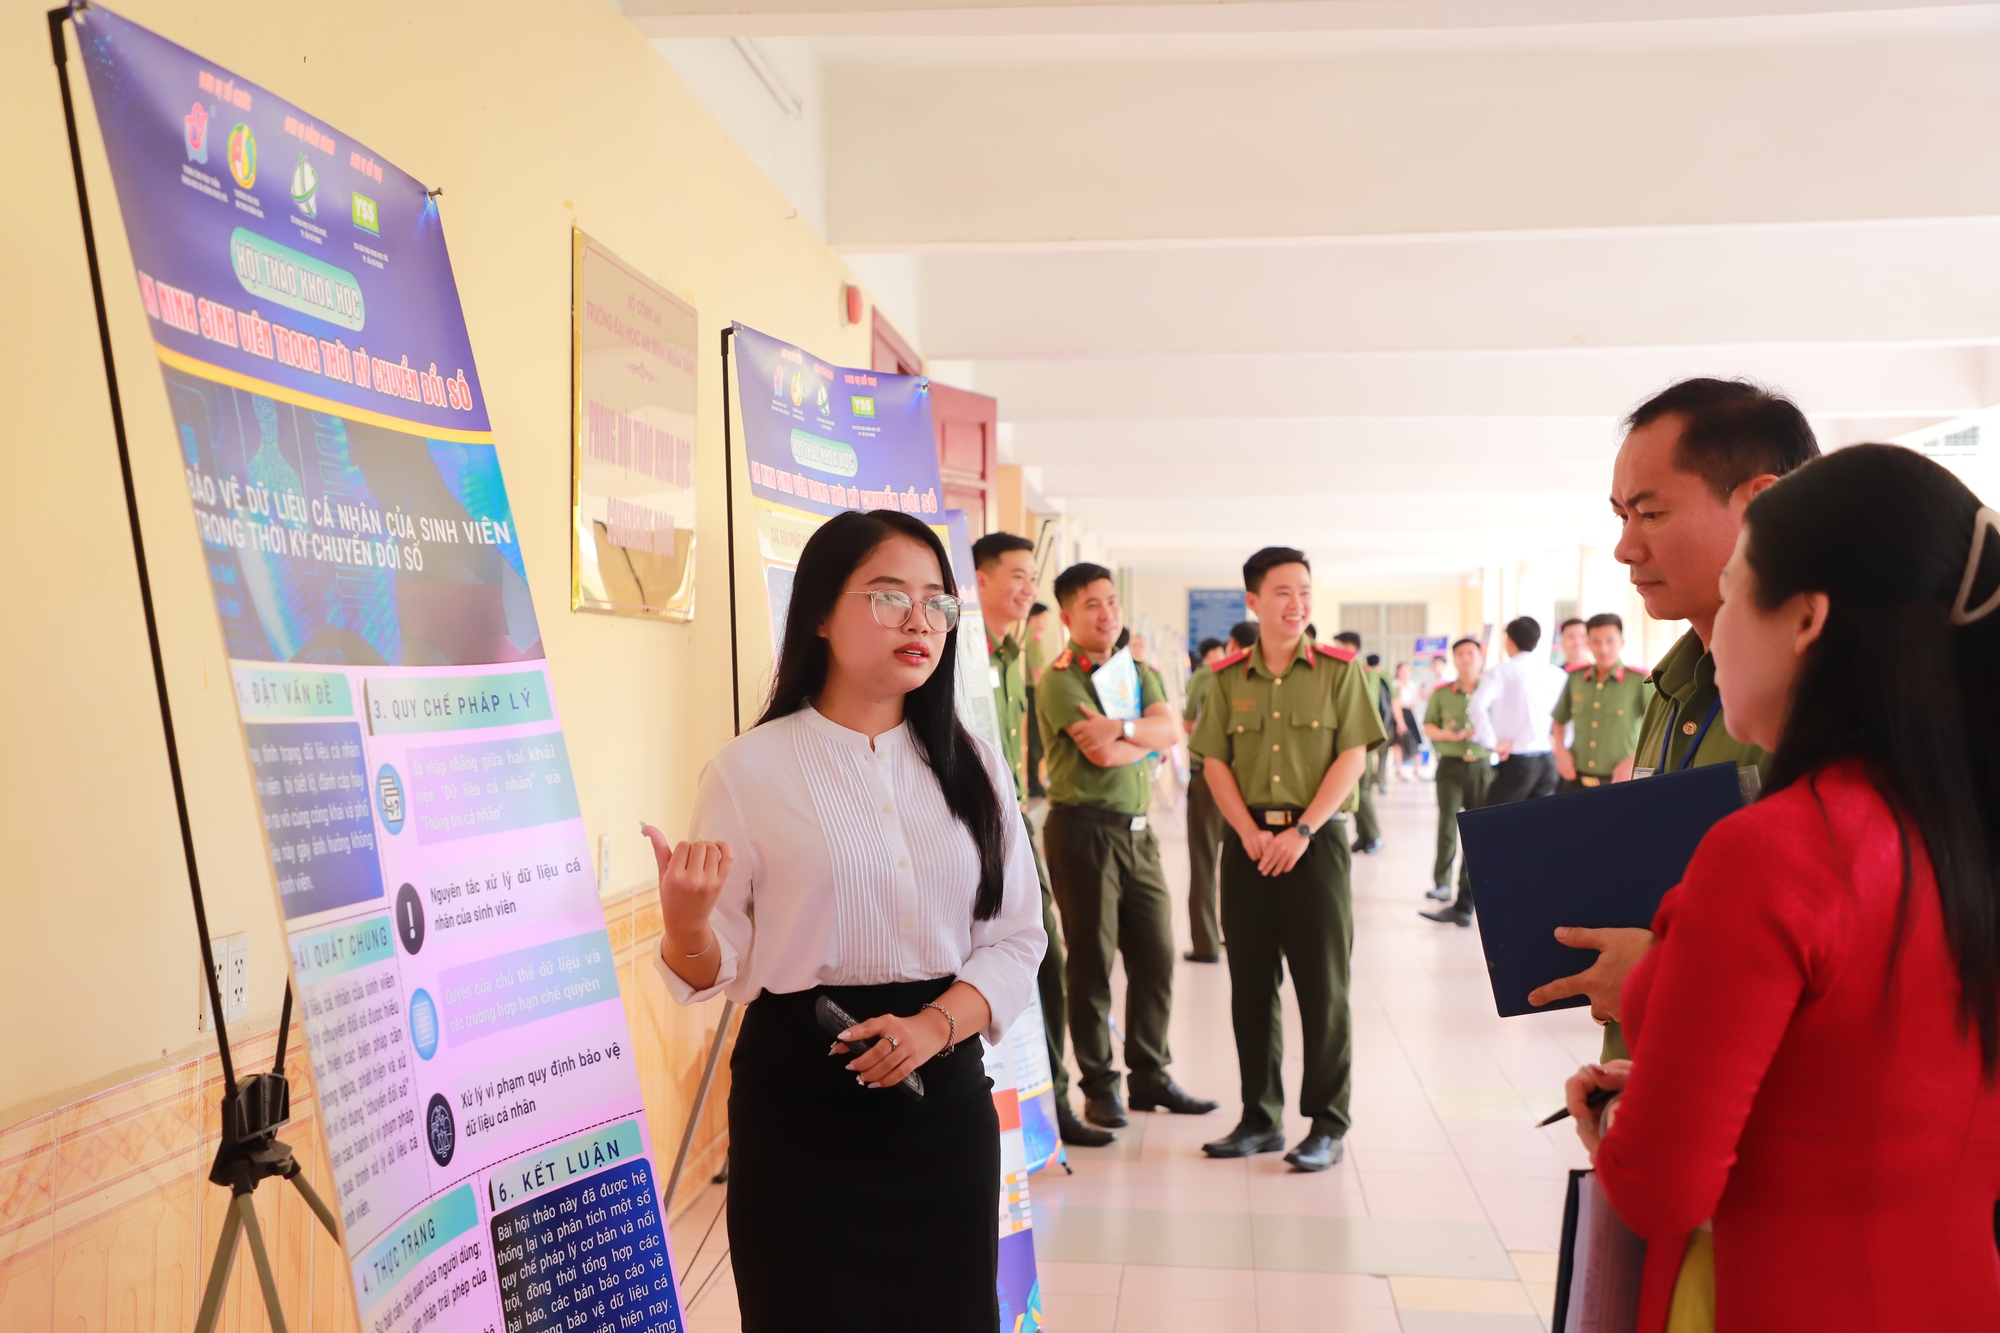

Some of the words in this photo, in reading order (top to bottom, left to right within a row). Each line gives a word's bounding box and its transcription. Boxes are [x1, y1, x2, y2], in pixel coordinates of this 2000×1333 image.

[354, 196, 374, 222] YSS
[236, 241, 260, 288] HỘI
[262, 252, 297, 297] THẢO
[299, 268, 333, 310] KHOA
[335, 281, 360, 323] HỌC
[156, 280, 198, 335] NINH
[198, 297, 237, 348] SINH
[237, 309, 273, 360] VIÊN
[273, 324, 320, 374] TRONG
[320, 338, 352, 383] THỜI
[353, 348, 370, 388] KỲ
[372, 354, 420, 402] CHUYỂN
[420, 362, 447, 408] ĐỔI
[447, 369, 472, 411] SỐ
[854, 398, 871, 412] YSS
[218, 475, 242, 517] VỆ
[245, 481, 269, 516] DỮ
[274, 488, 308, 524] LIỆU
[312, 495, 334, 528] CÁ
[337, 502, 381, 535] NHÂN
[386, 505, 416, 539] CỦA
[420, 517, 458, 543] SINH
[462, 516, 511, 544] VIÊN
[900, 486, 920, 513] ĐỔI
[921, 488, 937, 513] SỐ
[247, 518, 287, 555] THỜI
[289, 523, 307, 558] KỲ
[312, 532, 372, 566] CHUYỂN
[376, 536, 401, 569] ĐỔI
[404, 540, 423, 571] SỐ
[252, 678, 276, 709] ĐẶT
[283, 678, 310, 704] VẤN
[316, 678, 331, 704] ĐỀ
[374, 700, 386, 719] 3.
[392, 699, 417, 720] QUY
[424, 692, 451, 716] CHẾ
[458, 691, 500, 715] PHÁP
[509, 687, 531, 710] LÝ
[481, 750, 503, 771] giữa
[507, 750, 523, 765] hai
[528, 744, 555, 761] khái
[462, 781, 480, 800] liệu
[486, 780, 498, 794] cá
[546, 769, 561, 785] và
[430, 882, 461, 906] Nguyên
[465, 878, 480, 896] tắc
[485, 873, 497, 892] xử
[502, 872, 512, 892] lý
[517, 867, 531, 884] dữ
[536, 862, 559, 884] liệu
[565, 857, 581, 874] cá
[434, 914, 455, 931] nhân
[456, 908, 472, 926] của
[474, 904, 493, 921] sinh
[495, 900, 516, 917] viên
[350, 926, 387, 955] CHUNG
[474, 976, 492, 995] của
[495, 969, 514, 989] chủ
[539, 961, 554, 978] dữ
[558, 954, 580, 973] liệu
[584, 949, 600, 965] và
[498, 1001, 516, 1019] hợp
[518, 992, 538, 1013] hạn
[541, 984, 561, 1006] chế
[564, 978, 600, 1001] quyền
[460, 1088, 473, 1109] Xử
[475, 1086, 483, 1107] lý
[486, 1082, 494, 1099] vi
[496, 1074, 525, 1099] phạm
[527, 1067, 547, 1087] quy
[550, 1054, 576, 1078] định
[578, 1048, 601, 1067] bảo
[604, 1042, 621, 1059] vệ
[465, 1118, 477, 1137] dữ
[478, 1112, 495, 1133] liệu
[496, 1106, 509, 1123] cá
[510, 1098, 536, 1120] nhân
[499, 1182, 514, 1202] 6.
[522, 1160, 555, 1192] KẾT
[567, 1138, 620, 1174] LUẬN
[498, 1223, 512, 1242] Bài
[514, 1217, 530, 1236] hội
[533, 1204, 556, 1224] thảo
[559, 1197, 578, 1219] này
[582, 1188, 596, 1206] đã
[600, 1178, 628, 1198] được
[631, 1168, 647, 1186] hệ
[498, 1243, 523, 1266] thống
[526, 1236, 538, 1254] lại
[541, 1229, 553, 1243] và
[556, 1221, 583, 1242] phân
[586, 1208, 606, 1227] tích
[610, 1198, 632, 1218] một
[636, 1188, 651, 1207] số
[374, 1246, 399, 1285] THỰC
[402, 1218, 435, 1259] TRẠNG
[425, 1266, 436, 1288] của
[438, 1256, 458, 1280] người
[501, 1272, 517, 1290] quy
[520, 1258, 537, 1279] chế
[540, 1249, 565, 1272] pháp
[568, 1242, 577, 1260] lý
[580, 1240, 594, 1252] cơ
[598, 1226, 617, 1246] bản
[620, 1219, 633, 1235] và
[637, 1210, 655, 1230] nổi
[504, 1294, 522, 1312] trội,
[526, 1278, 552, 1301] đồng
[556, 1266, 576, 1286] thời
[582, 1256, 606, 1275] tổng
[612, 1244, 633, 1264] hợp
[638, 1234, 659, 1250] các
[438, 1290, 450, 1312] trái
[452, 1278, 469, 1306] phép
[472, 1267, 487, 1288] của
[526, 1308, 547, 1325] báo,
[550, 1295, 570, 1313] các
[574, 1284, 594, 1305] bản
[599, 1274, 620, 1291] báo
[624, 1263, 645, 1279] cáo
[650, 1252, 664, 1269] về
[566, 1310, 587, 1330] bảo
[592, 1301, 605, 1318] vệ
[610, 1292, 624, 1310] dữ
[628, 1284, 649, 1303] liệu
[654, 1274, 668, 1291] cá
[620, 1310, 644, 1329] hiện
[648, 1298, 672, 1316] nay.
